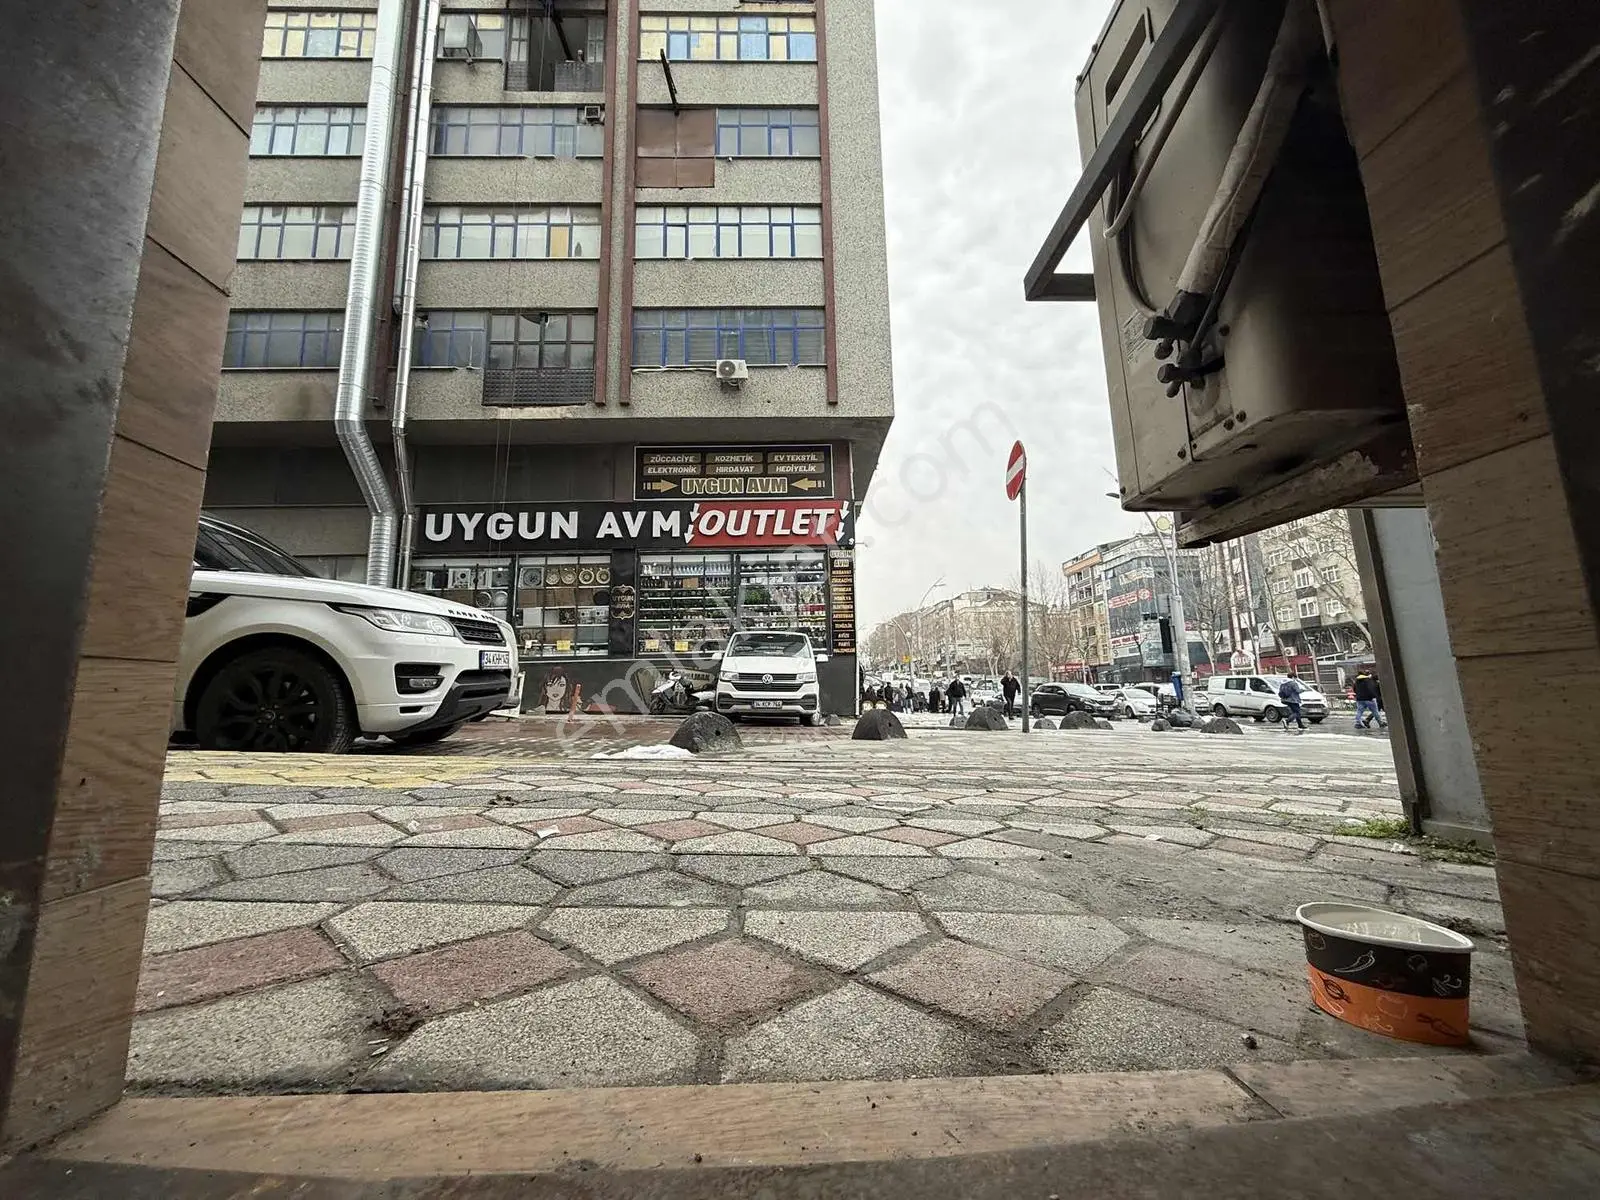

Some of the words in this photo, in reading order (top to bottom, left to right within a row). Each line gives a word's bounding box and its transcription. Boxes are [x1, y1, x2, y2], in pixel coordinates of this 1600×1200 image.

[650, 454, 695, 463] ZÜCCACİYE
[714, 453, 754, 462] KOZMETİK
[774, 454, 785, 462] EV
[786, 453, 818, 461] TEKSTİL
[647, 464, 697, 474] ELEKTRONİK
[715, 465, 755, 473] HIRDAVAT
[775, 464, 817, 473] HEDİYELİK
[681, 478, 745, 495] UYGUN
[747, 476, 788, 494] AVM
[425, 511, 579, 542] UYGUN
[596, 510, 681, 539] AVM
[698, 508, 836, 536] OUTLET
